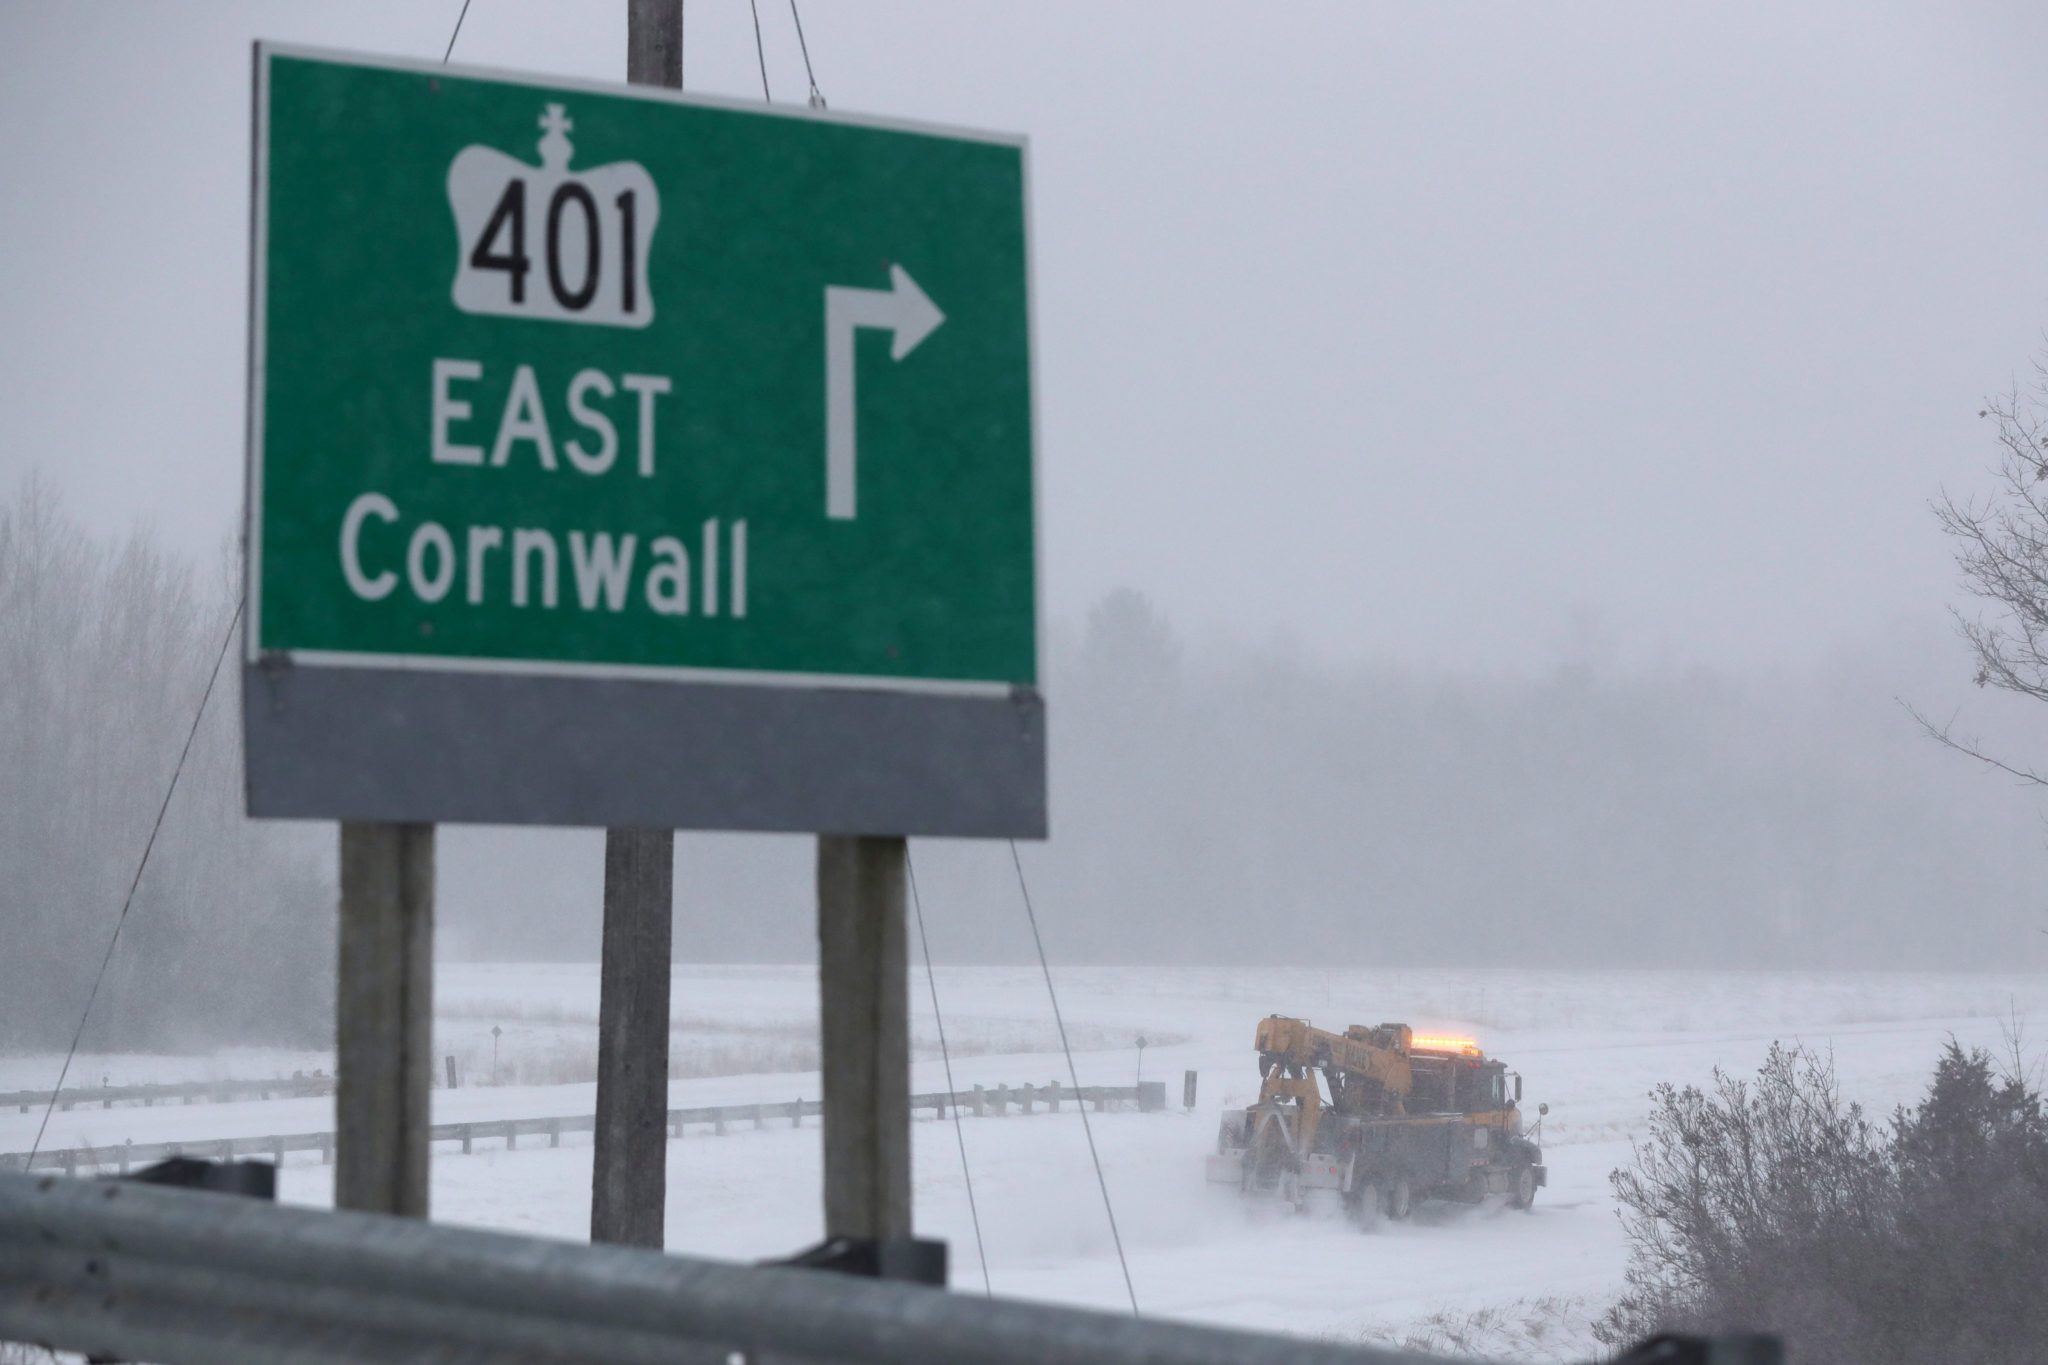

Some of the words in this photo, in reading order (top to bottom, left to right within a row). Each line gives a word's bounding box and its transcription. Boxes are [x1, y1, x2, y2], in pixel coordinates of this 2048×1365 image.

[469, 177, 638, 315] 401
[431, 359, 673, 477] EAST
[339, 492, 748, 618] Cornwall
